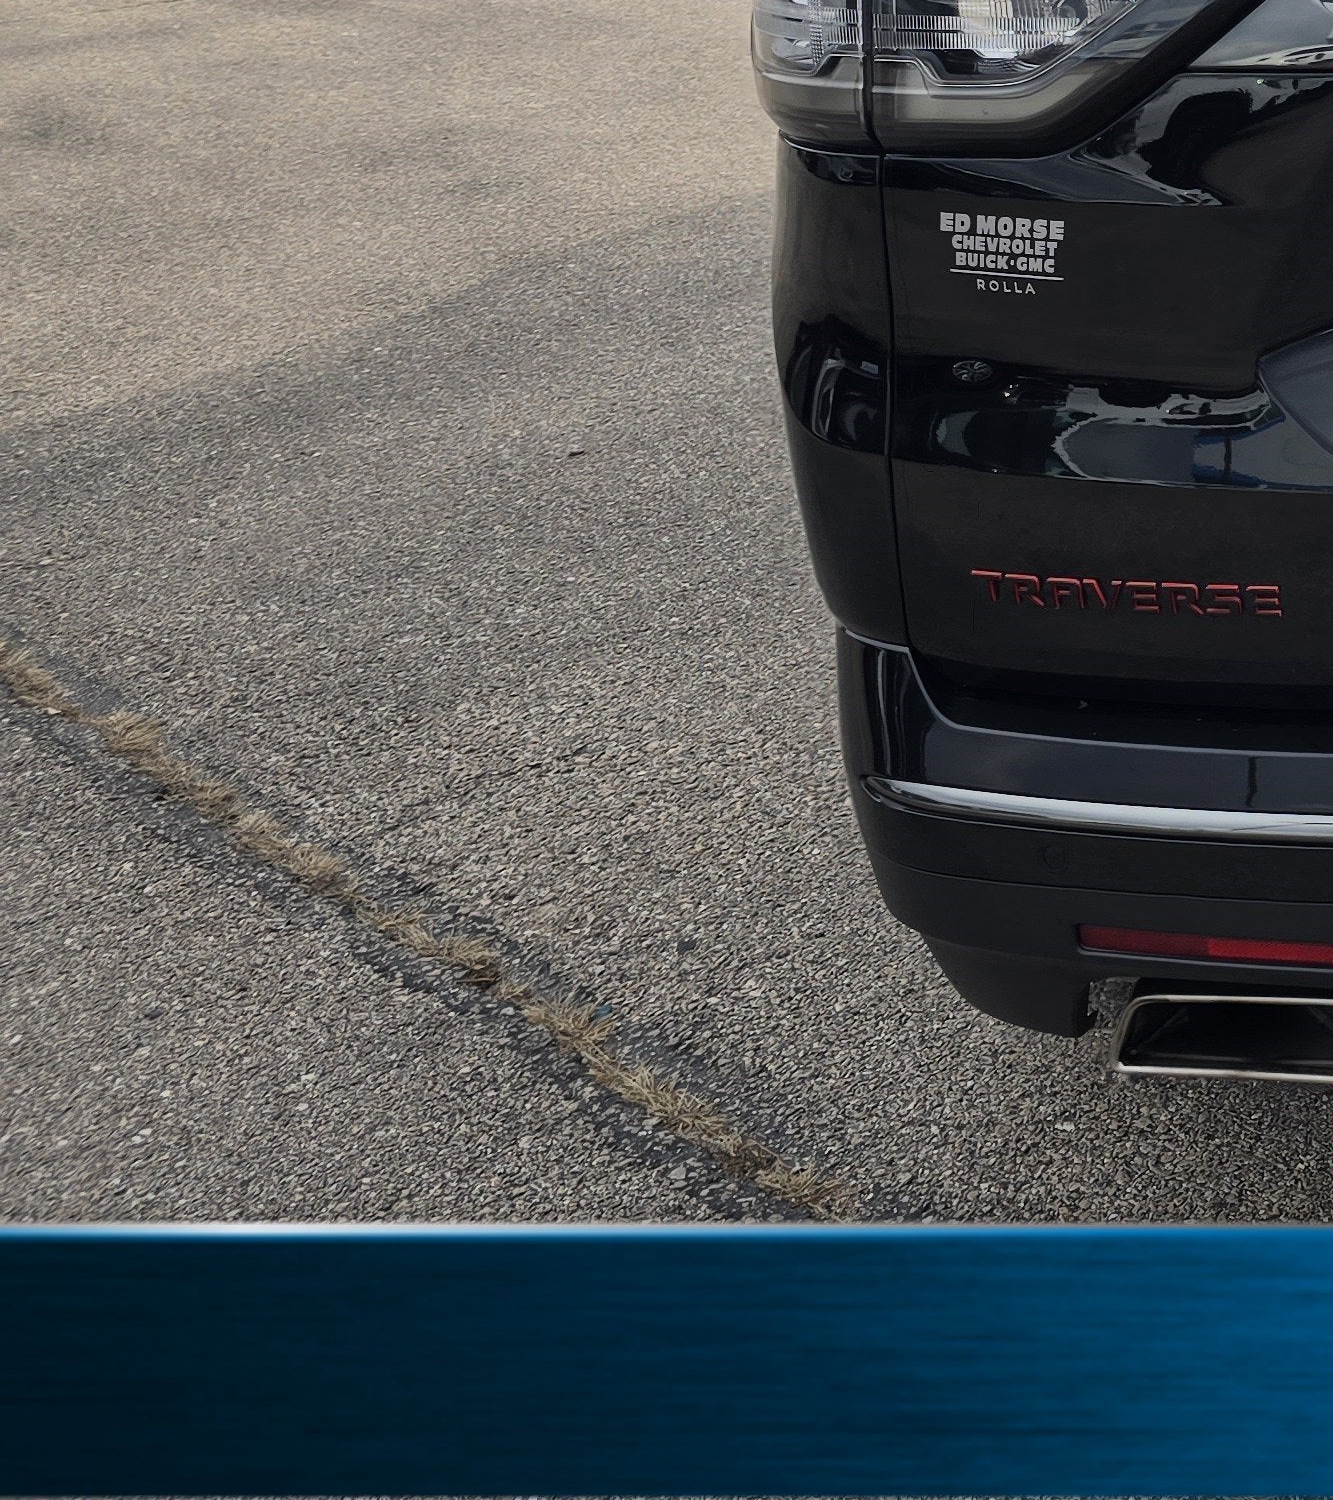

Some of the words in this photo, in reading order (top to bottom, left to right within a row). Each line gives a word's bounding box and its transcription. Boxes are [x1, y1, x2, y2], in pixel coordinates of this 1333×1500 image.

[939, 211, 972, 233] ED
[976, 214, 1065, 241] MORSE
[951, 234, 1058, 257] CHEVROLET
[975, 278, 1036, 295] ROLLA
[970, 568, 1283, 619] TRAVERSE
